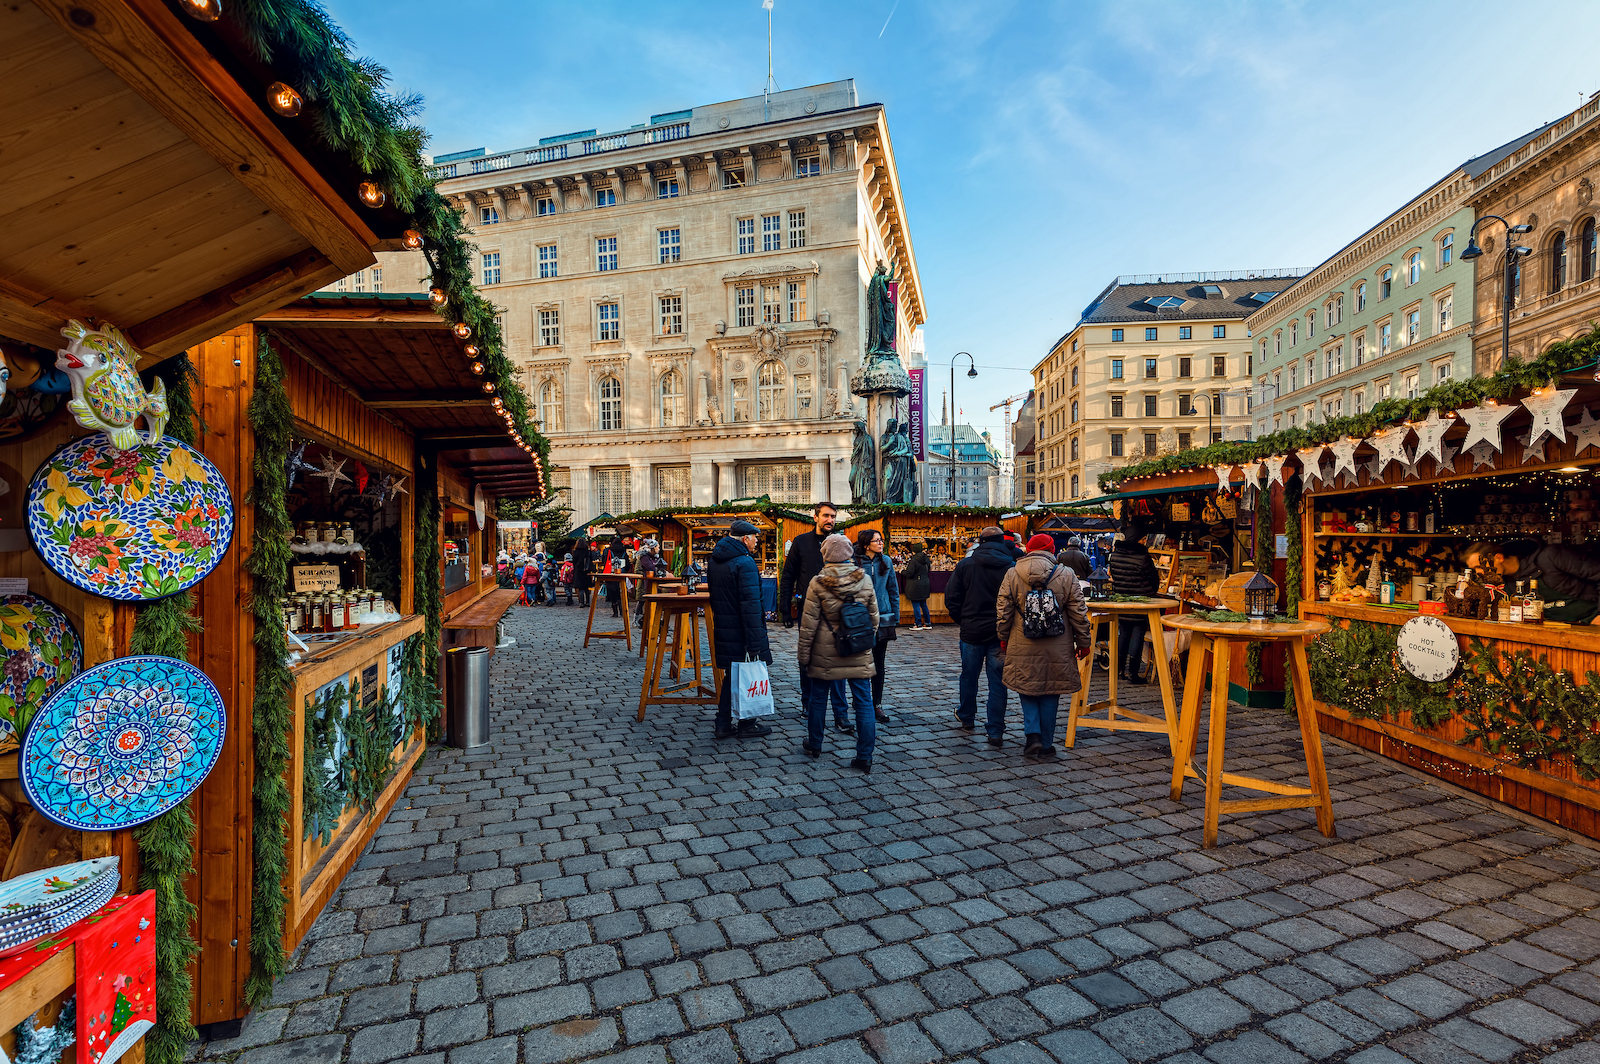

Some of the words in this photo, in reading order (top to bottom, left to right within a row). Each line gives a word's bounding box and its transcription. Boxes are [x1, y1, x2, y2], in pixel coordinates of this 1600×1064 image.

[911, 373, 920, 405] PIERRE
[911, 410, 921, 455] BONNARD
[1408, 642, 1446, 659] COCKTAILS
[1420, 637, 1435, 647] HOT
